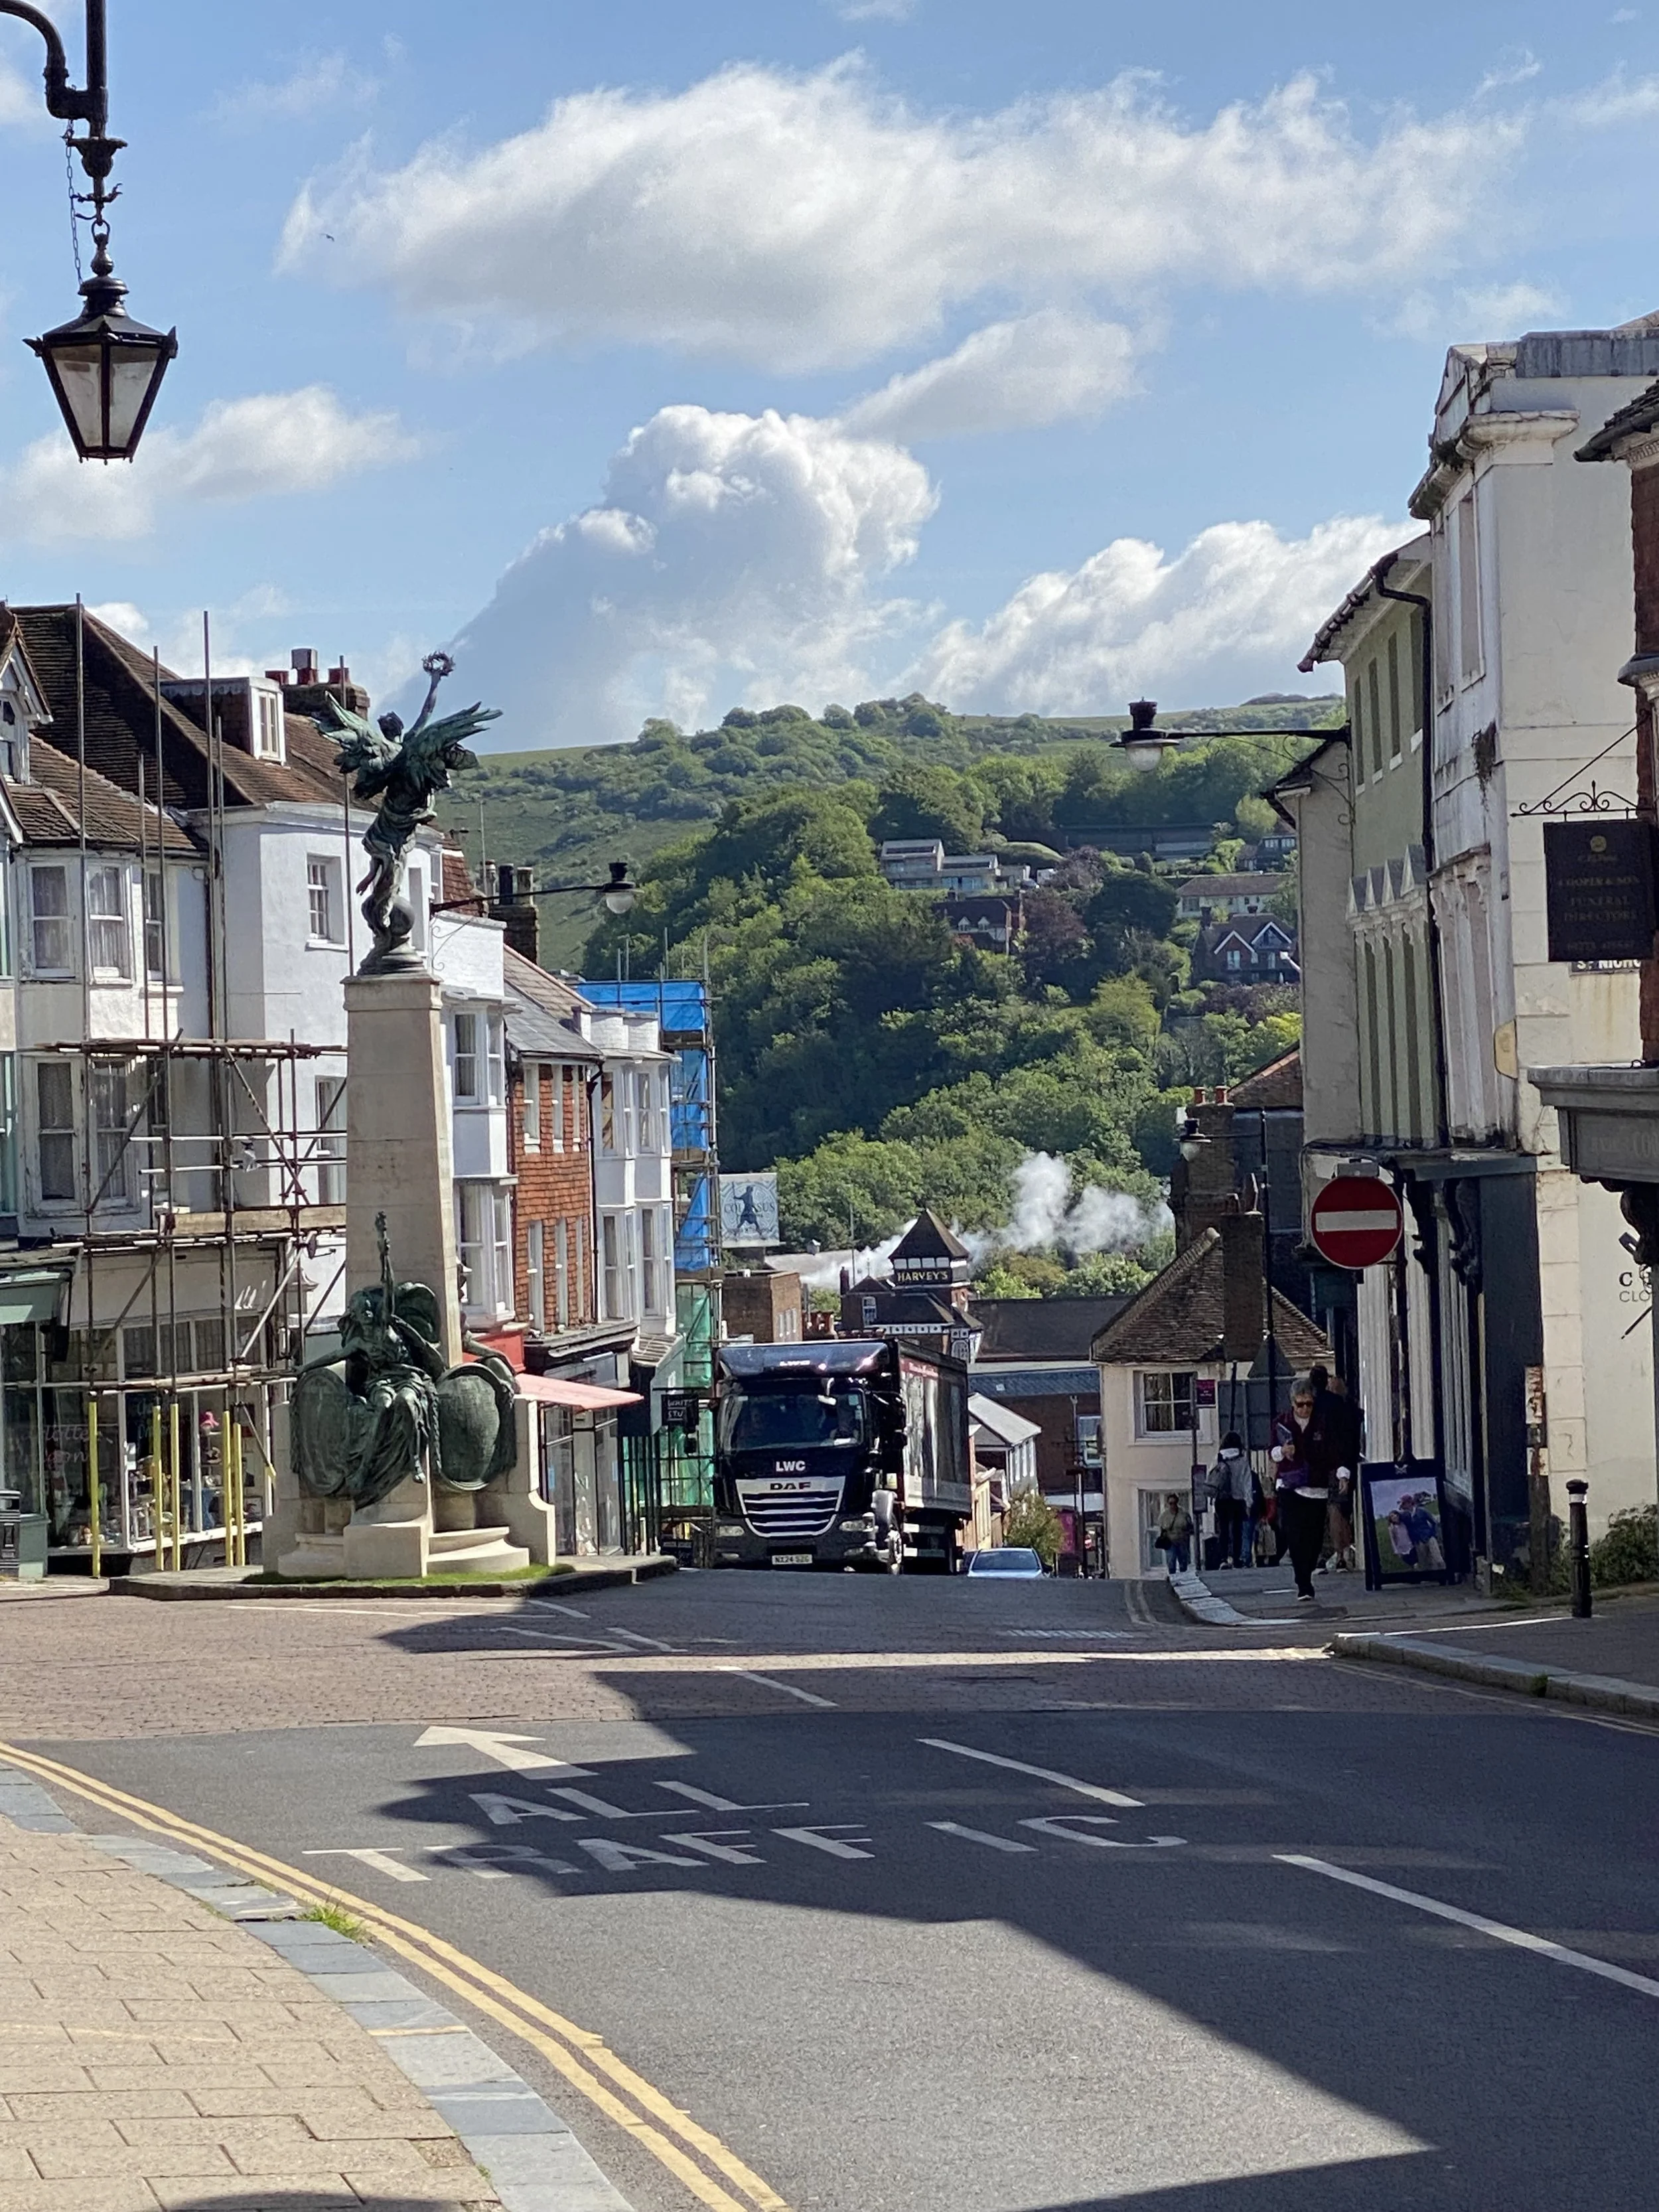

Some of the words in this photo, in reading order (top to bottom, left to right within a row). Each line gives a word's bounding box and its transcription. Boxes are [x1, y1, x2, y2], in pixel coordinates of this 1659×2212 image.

[1599, 958, 1642, 970] NICHO
[898, 1270, 948, 1282] HARVEY'S
[776, 1460, 806, 1472] LWC
[770, 1481, 811, 1491] DAF
[468, 1781, 810, 1825] ALL
[302, 1814, 1188, 1882] TRAFFIC
